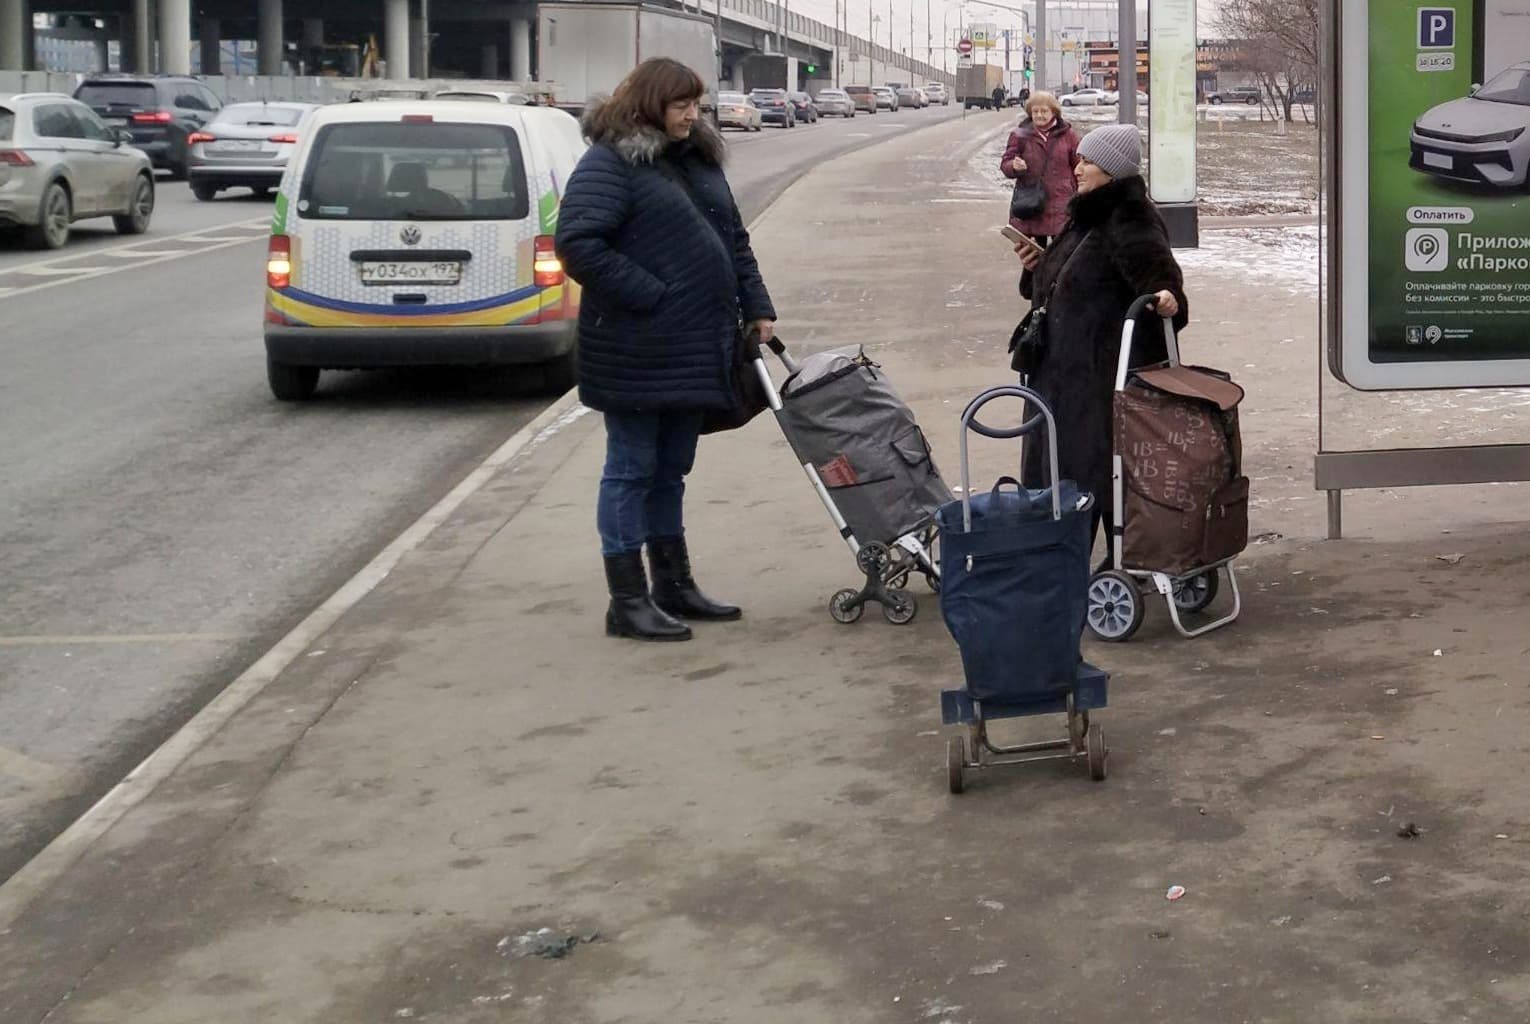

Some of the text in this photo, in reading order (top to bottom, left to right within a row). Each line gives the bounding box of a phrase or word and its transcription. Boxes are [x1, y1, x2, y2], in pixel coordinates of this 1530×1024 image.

[1413, 209, 1466, 220] Оплатить
[1405, 281, 1467, 291] Оплачивайте
[1469, 283, 1513, 292] парковку
[1405, 293, 1422, 303] без
[1424, 295, 1470, 303] комиссии
[1480, 295, 1495, 303] это
